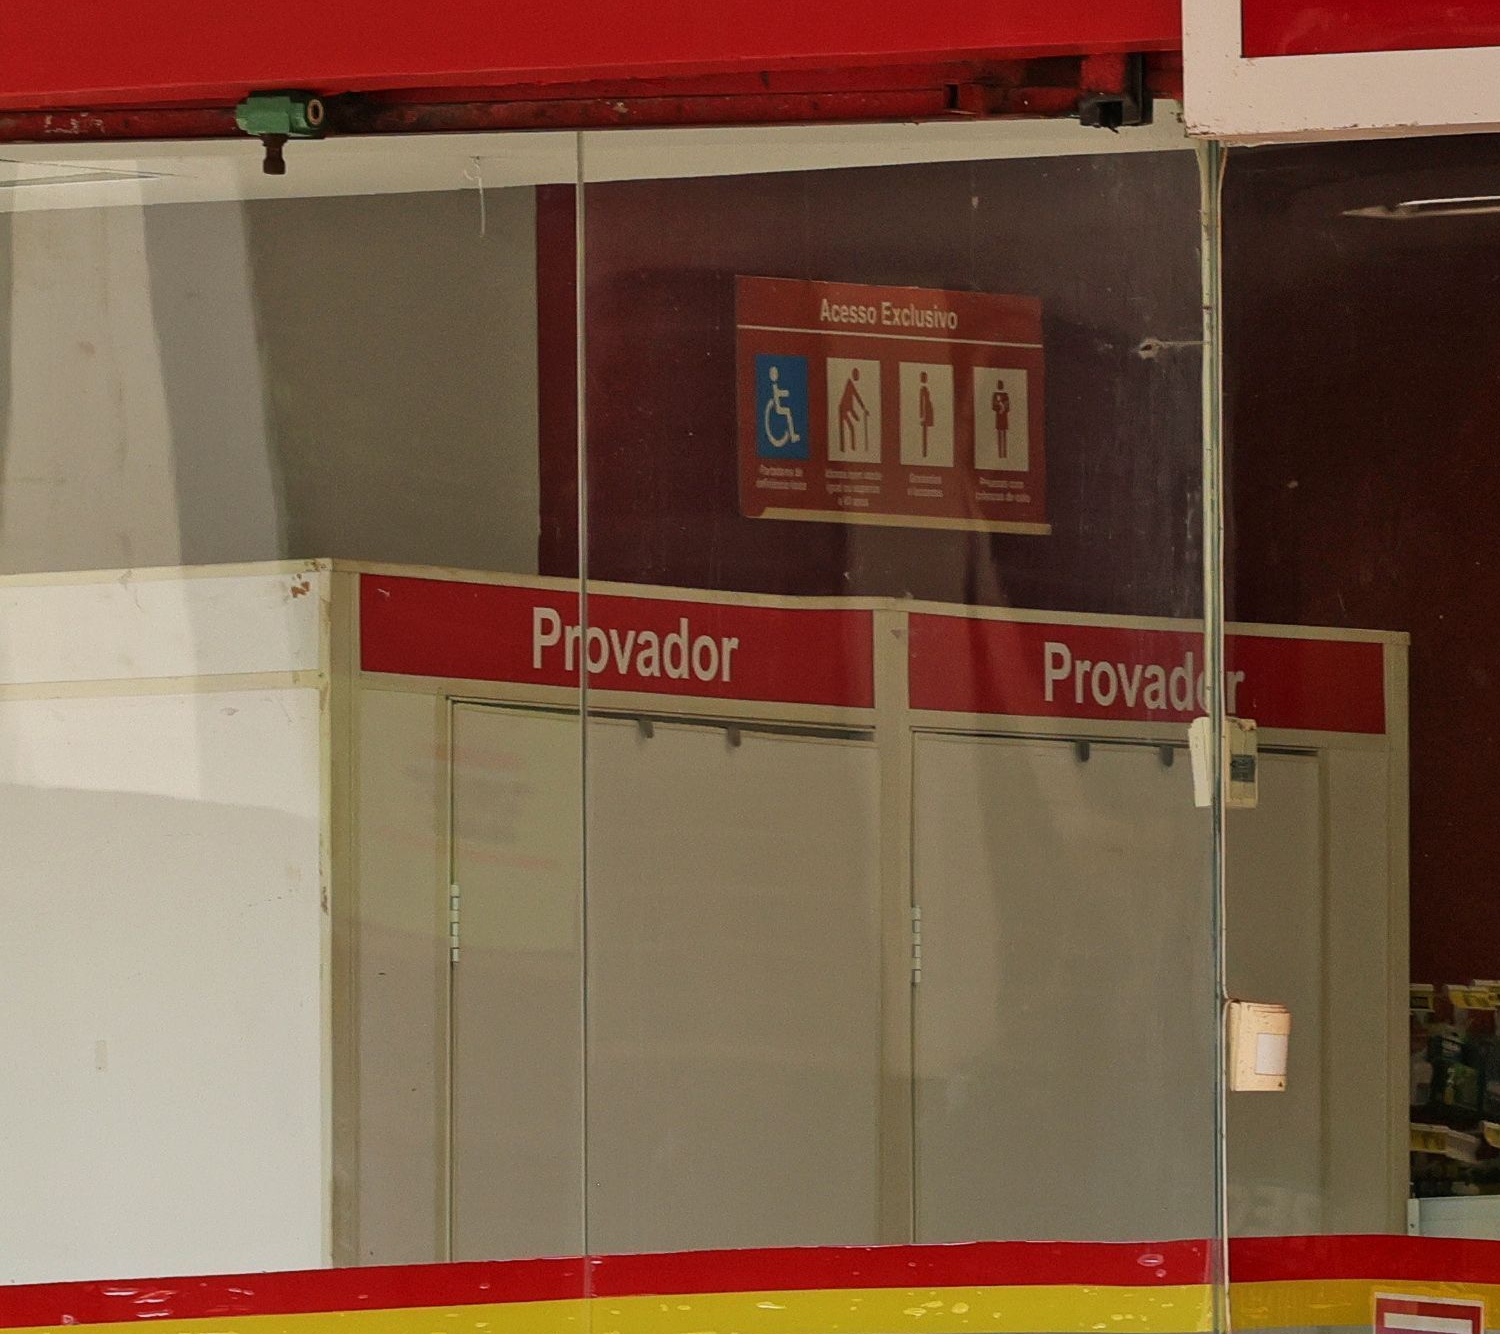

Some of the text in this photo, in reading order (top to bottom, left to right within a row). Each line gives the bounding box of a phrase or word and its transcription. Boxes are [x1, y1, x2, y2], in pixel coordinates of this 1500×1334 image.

[820, 298, 958, 330] Acesso Exclusivo
[533, 606, 739, 685] Provador
